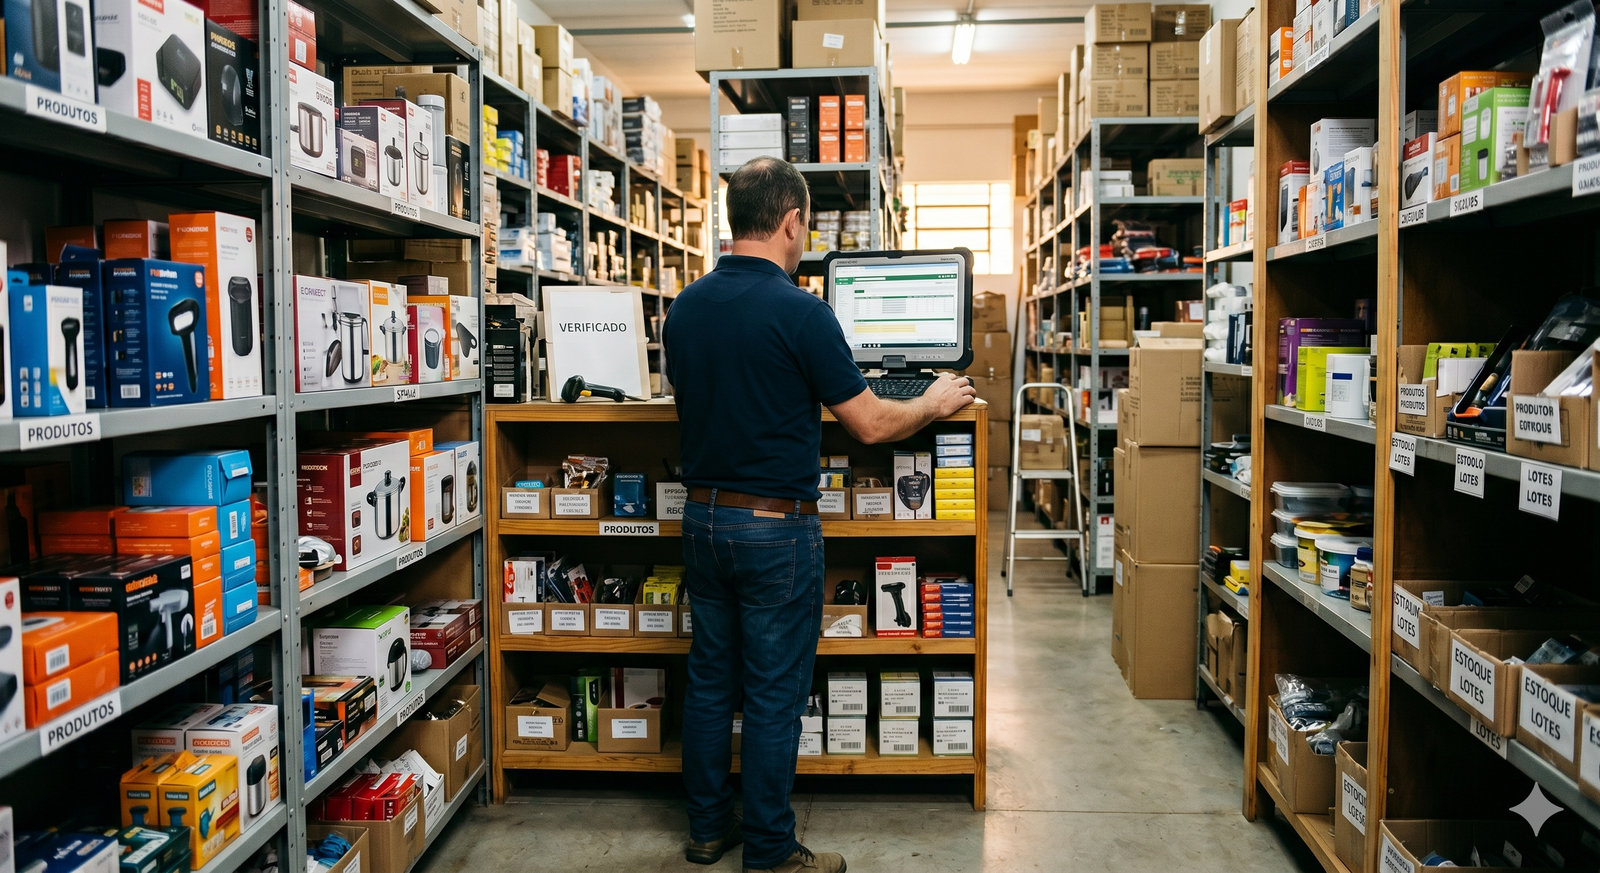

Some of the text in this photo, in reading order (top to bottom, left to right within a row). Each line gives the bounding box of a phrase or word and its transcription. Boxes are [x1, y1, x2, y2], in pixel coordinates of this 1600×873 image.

[37, 96, 98, 125] PRODUTOS
[559, 322, 627, 333] VERIFICADO
[1515, 402, 1554, 417] PRODUTOR
[28, 421, 93, 442] PRODUTOS
[1394, 453, 1411, 466] LOTES
[1459, 471, 1479, 487] LOTES
[1528, 469, 1553, 487] LOTES
[1526, 489, 1553, 508] LOTES
[604, 525, 655, 534] PRODUTOS
[1397, 614, 1416, 637] LOTES
[1455, 647, 1492, 685] ESTOQUE
[1460, 675, 1484, 705] LOTES
[1525, 676, 1571, 719] ESTOQUE
[48, 701, 115, 746] PRODUTOS
[1531, 707, 1561, 741] LOTES
[1475, 721, 1501, 751] LOTES
